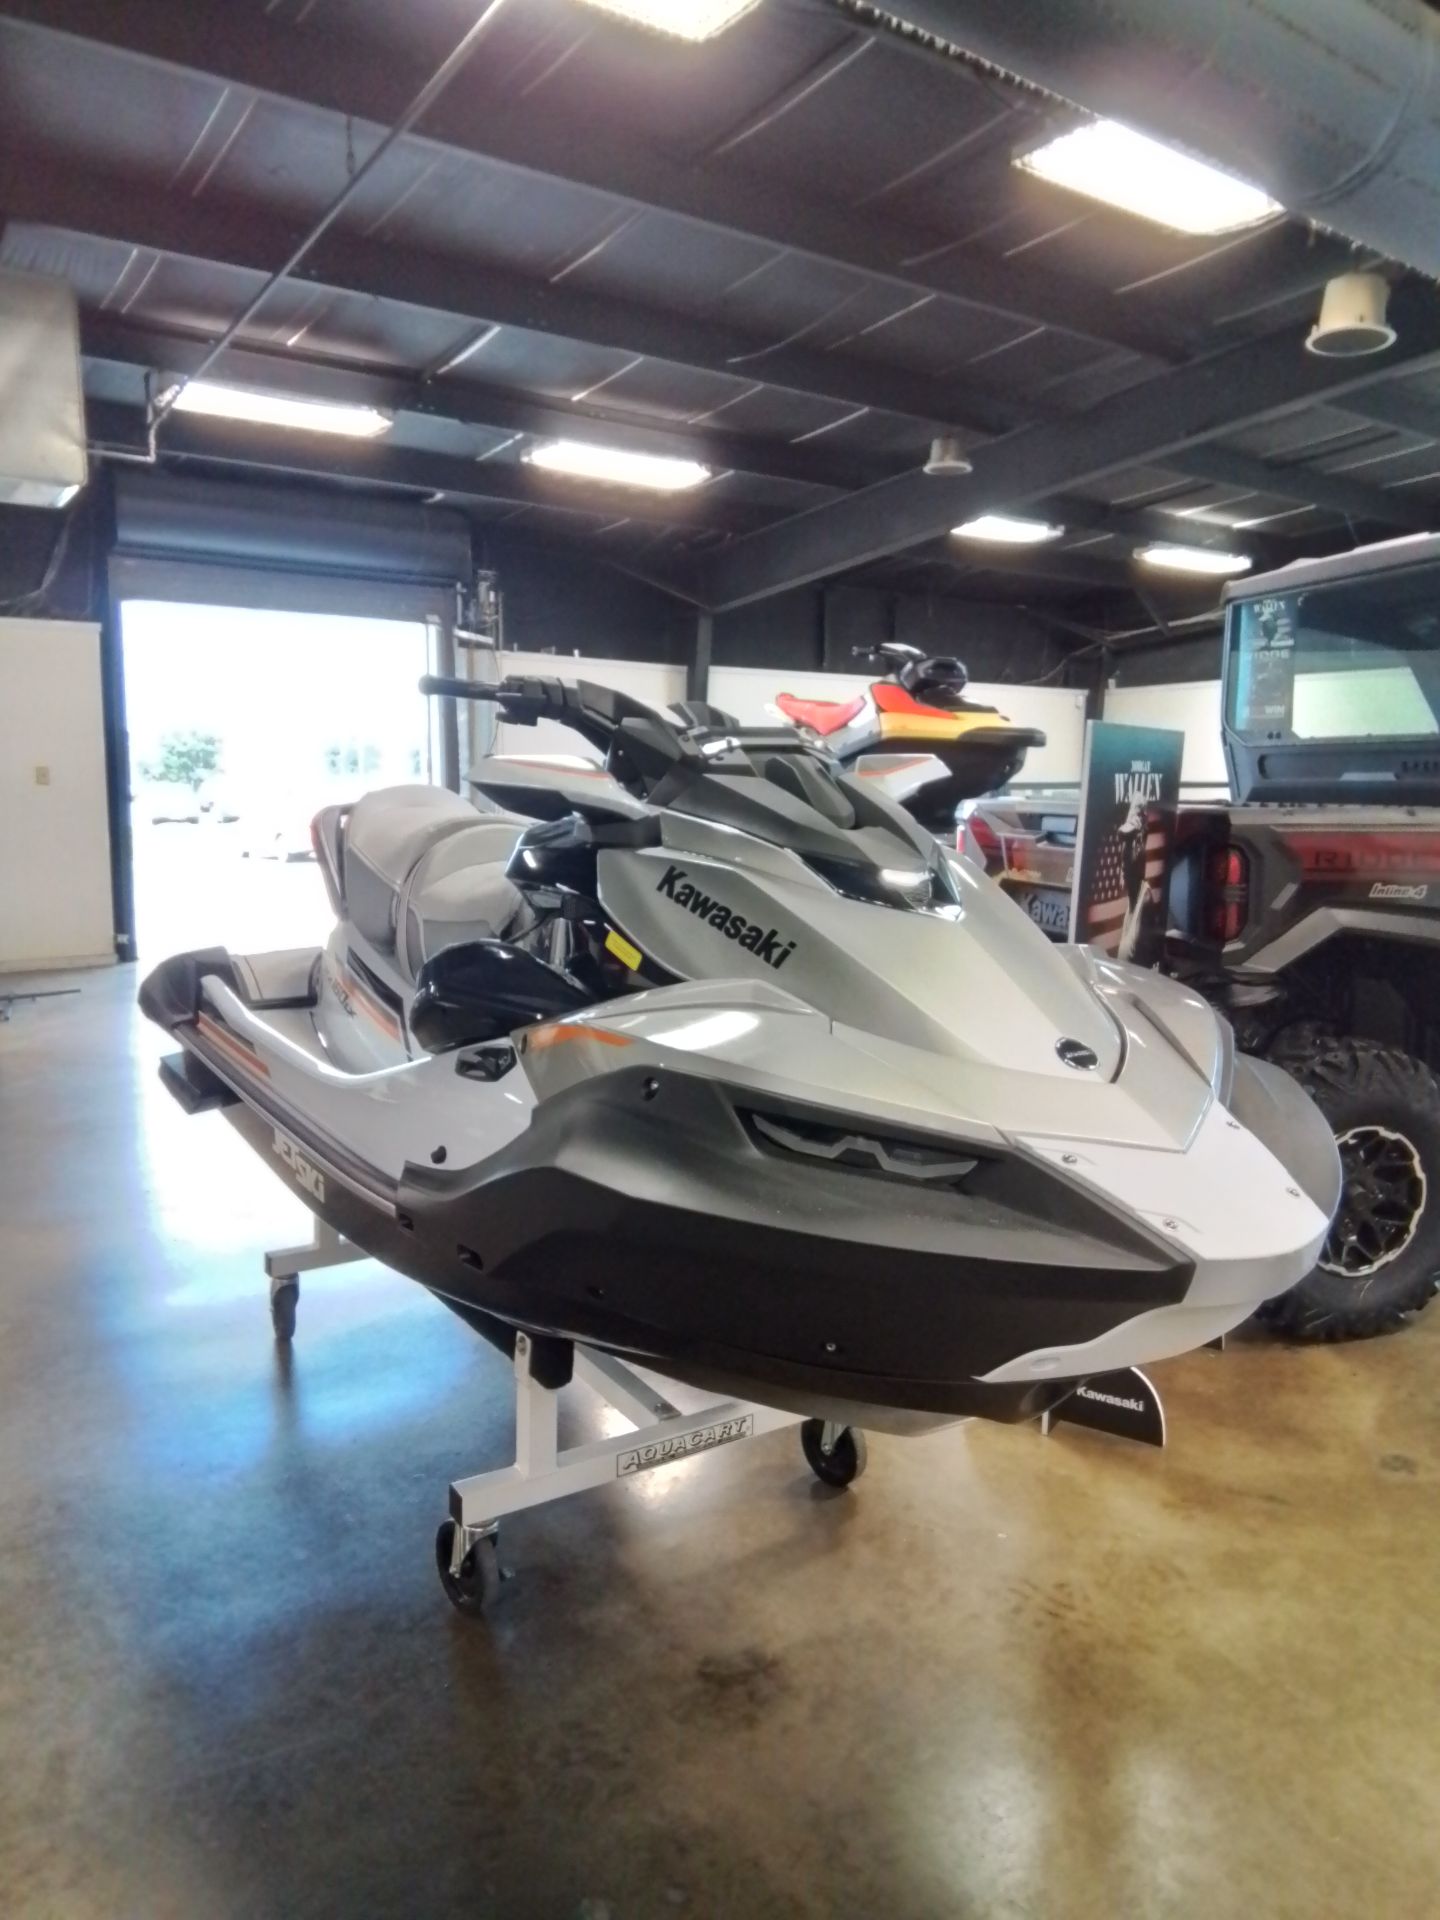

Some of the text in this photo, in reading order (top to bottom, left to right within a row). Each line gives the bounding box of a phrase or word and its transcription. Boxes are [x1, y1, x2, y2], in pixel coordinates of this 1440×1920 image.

[656, 865, 797, 969] Kawasaki
[1076, 1386, 1144, 1412] Kawasaki
[623, 1418, 746, 1470] AQUACART
